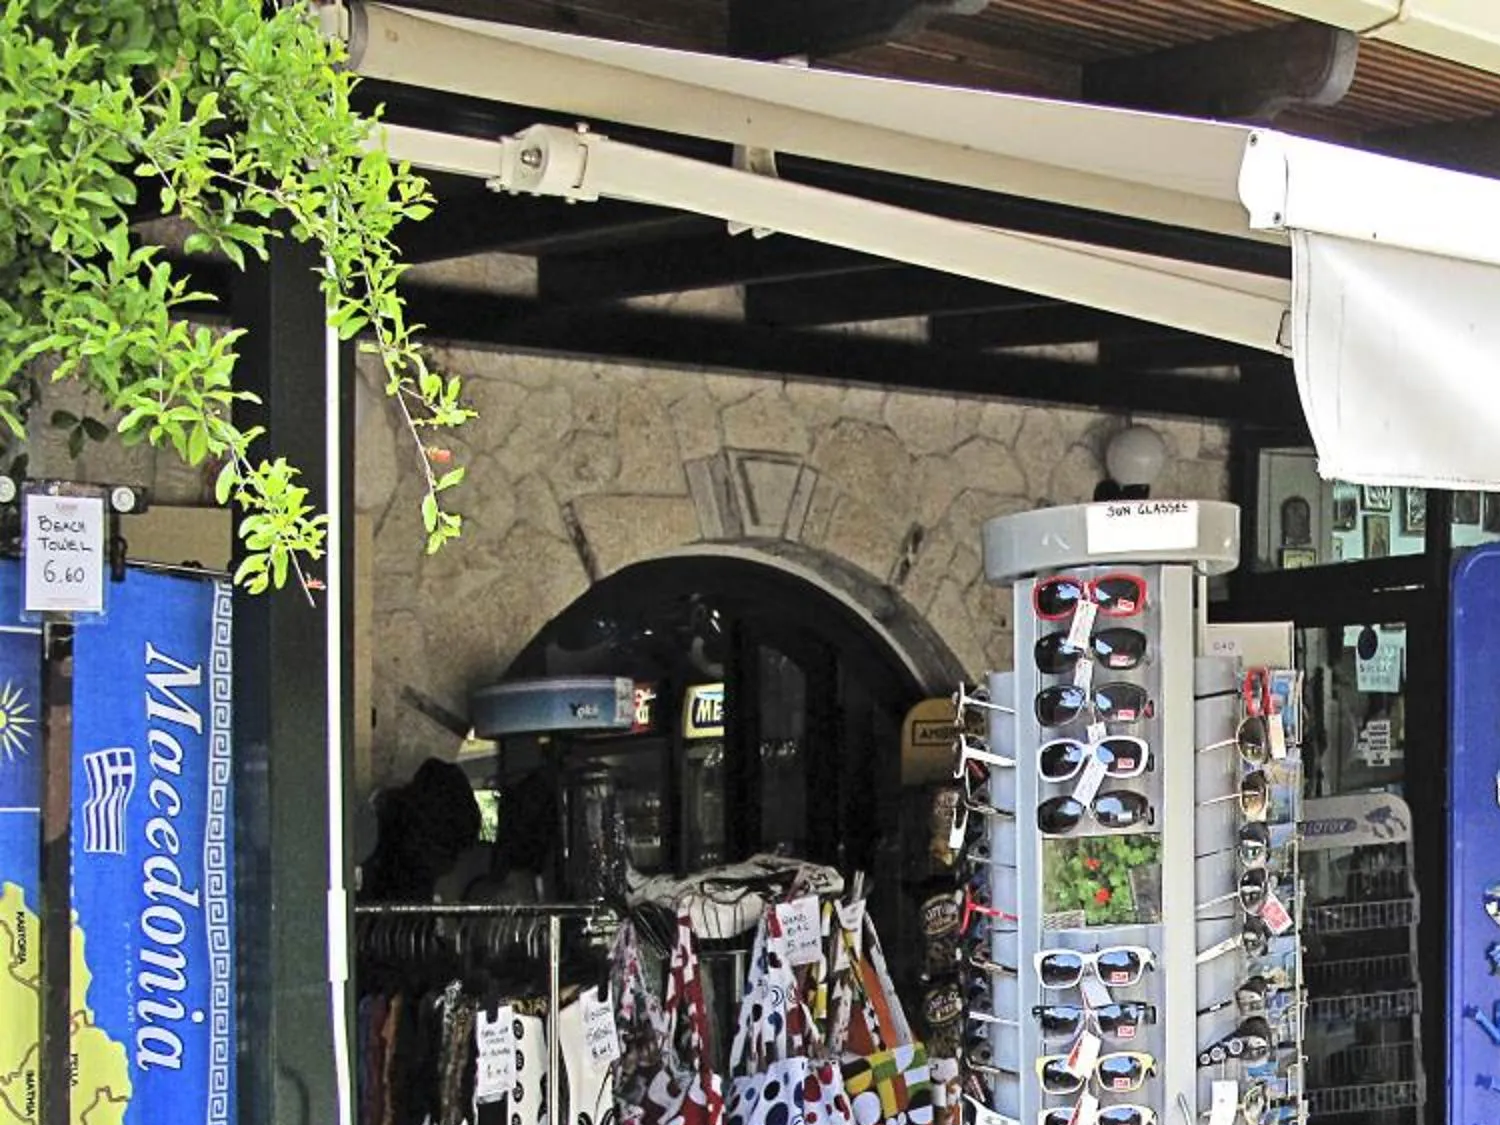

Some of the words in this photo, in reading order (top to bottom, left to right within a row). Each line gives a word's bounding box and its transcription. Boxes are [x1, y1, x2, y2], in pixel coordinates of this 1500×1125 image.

[37, 514, 86, 533] BEACH
[37, 537, 93, 552] TOWEL
[136, 642, 205, 1072] Macedonia
